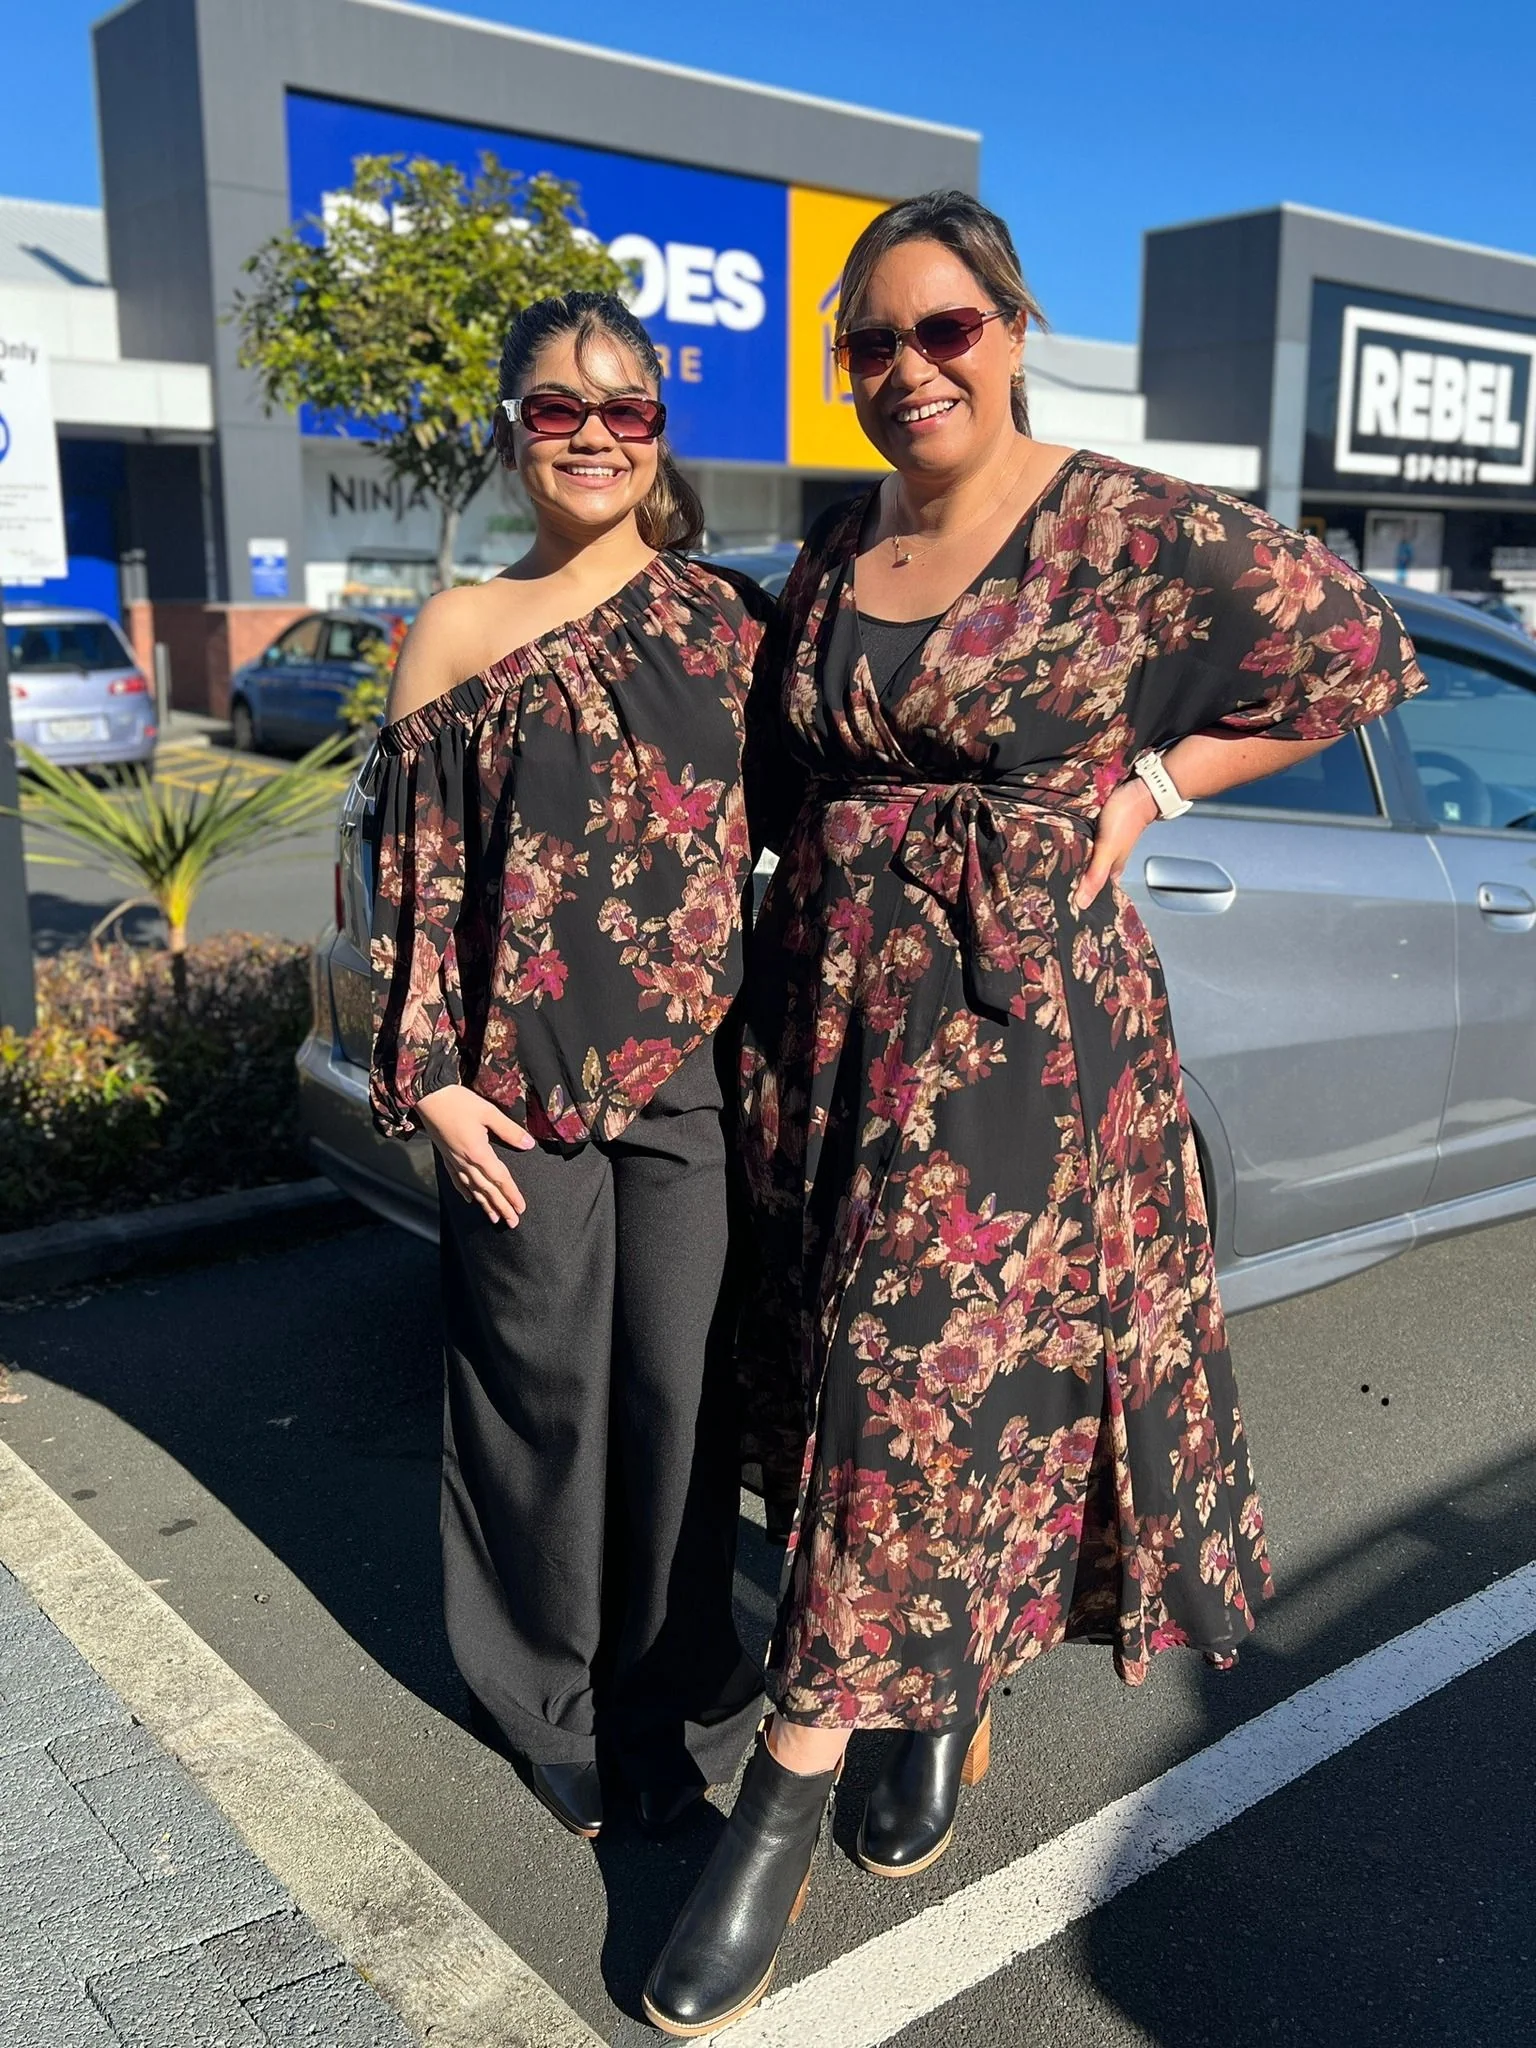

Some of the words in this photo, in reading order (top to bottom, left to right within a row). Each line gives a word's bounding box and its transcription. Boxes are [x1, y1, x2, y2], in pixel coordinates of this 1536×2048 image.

[321, 190, 766, 331] BOES
[1358, 344, 1521, 449] REBEL
[328, 470, 430, 523] NINJA
[1403, 453, 1478, 485] SPORT
